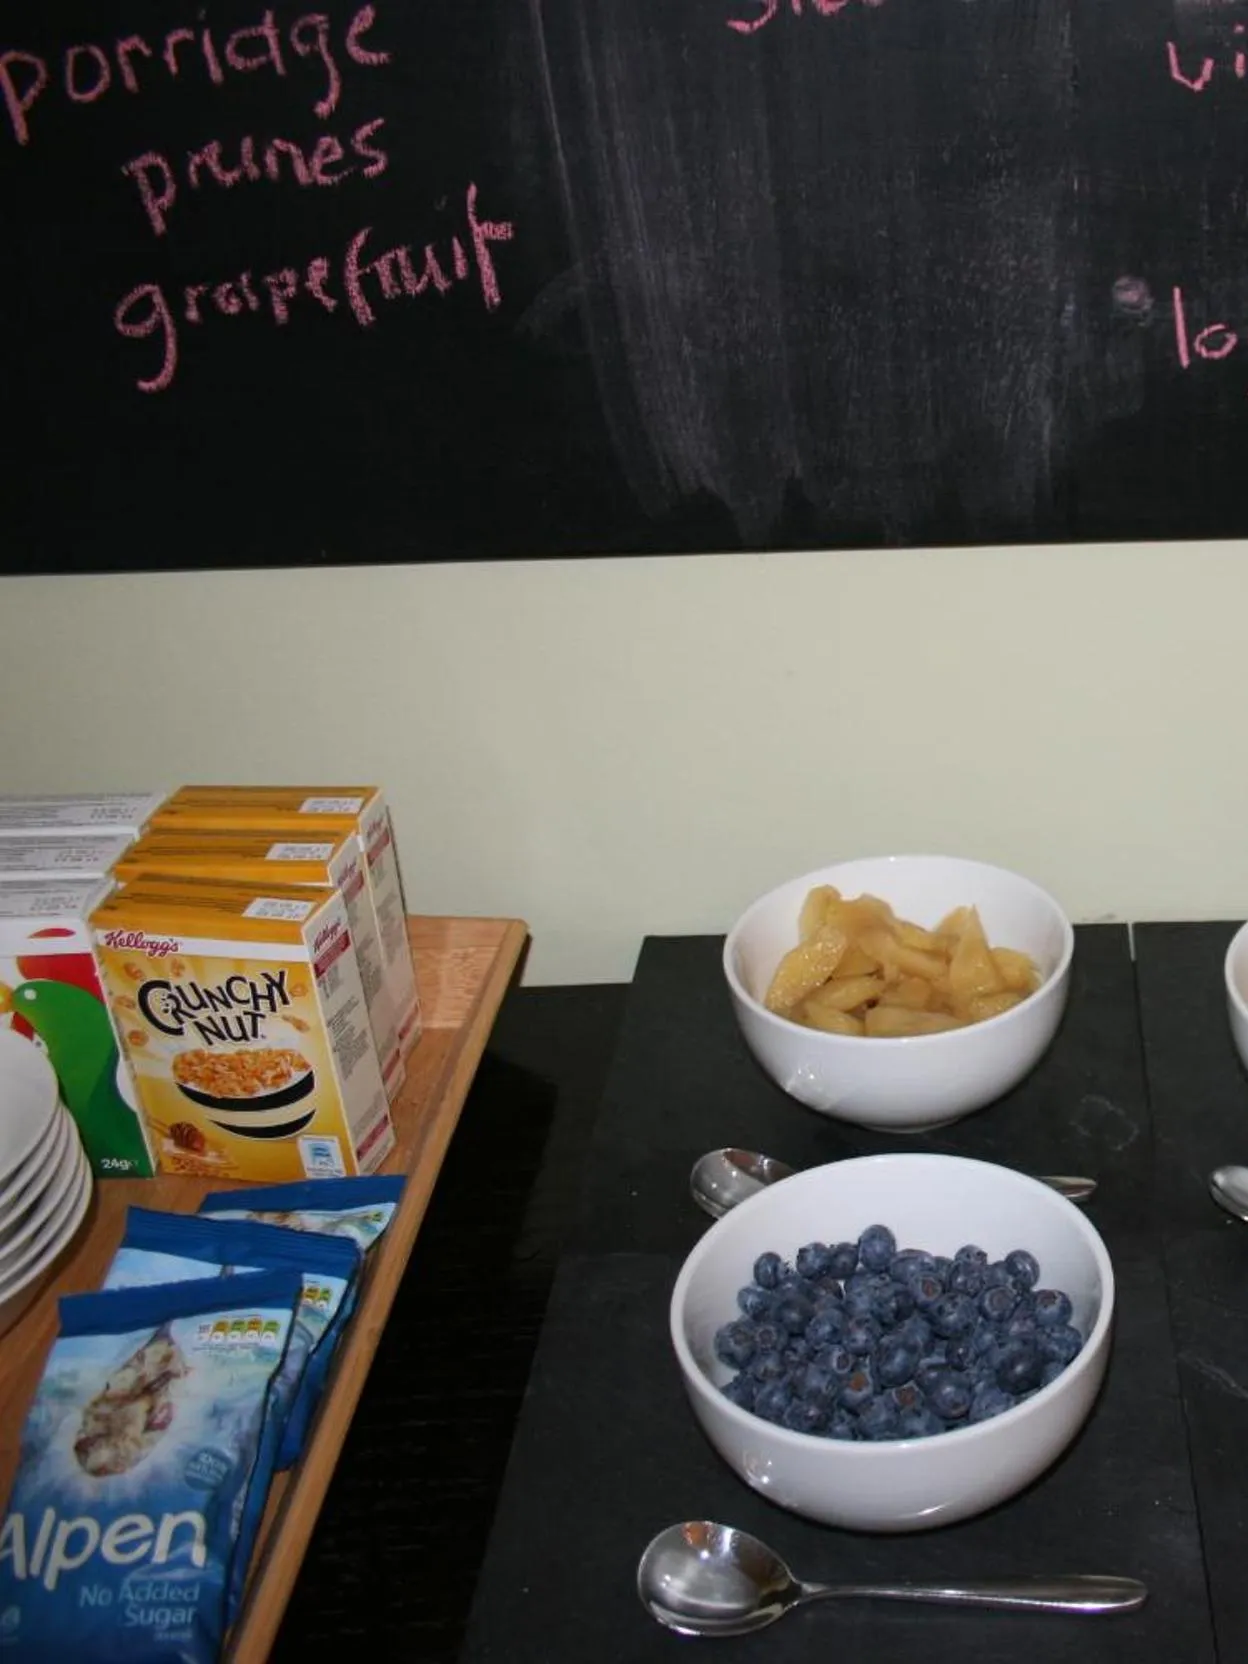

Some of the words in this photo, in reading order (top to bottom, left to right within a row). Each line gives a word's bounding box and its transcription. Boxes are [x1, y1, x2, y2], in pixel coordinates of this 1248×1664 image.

[0, 3, 391, 145] porridge
[120, 117, 389, 236] prunes
[113, 181, 515, 392] grapefruit
[104, 929, 181, 957] Kellogg's
[137, 969, 291, 1036] CRUNCHY
[193, 1011, 266, 1046] NUT
[0, 1506, 208, 1591] Alpen
[78, 1583, 113, 1608] No
[118, 1578, 200, 1602] Added
[123, 1604, 197, 1629] Sugar
